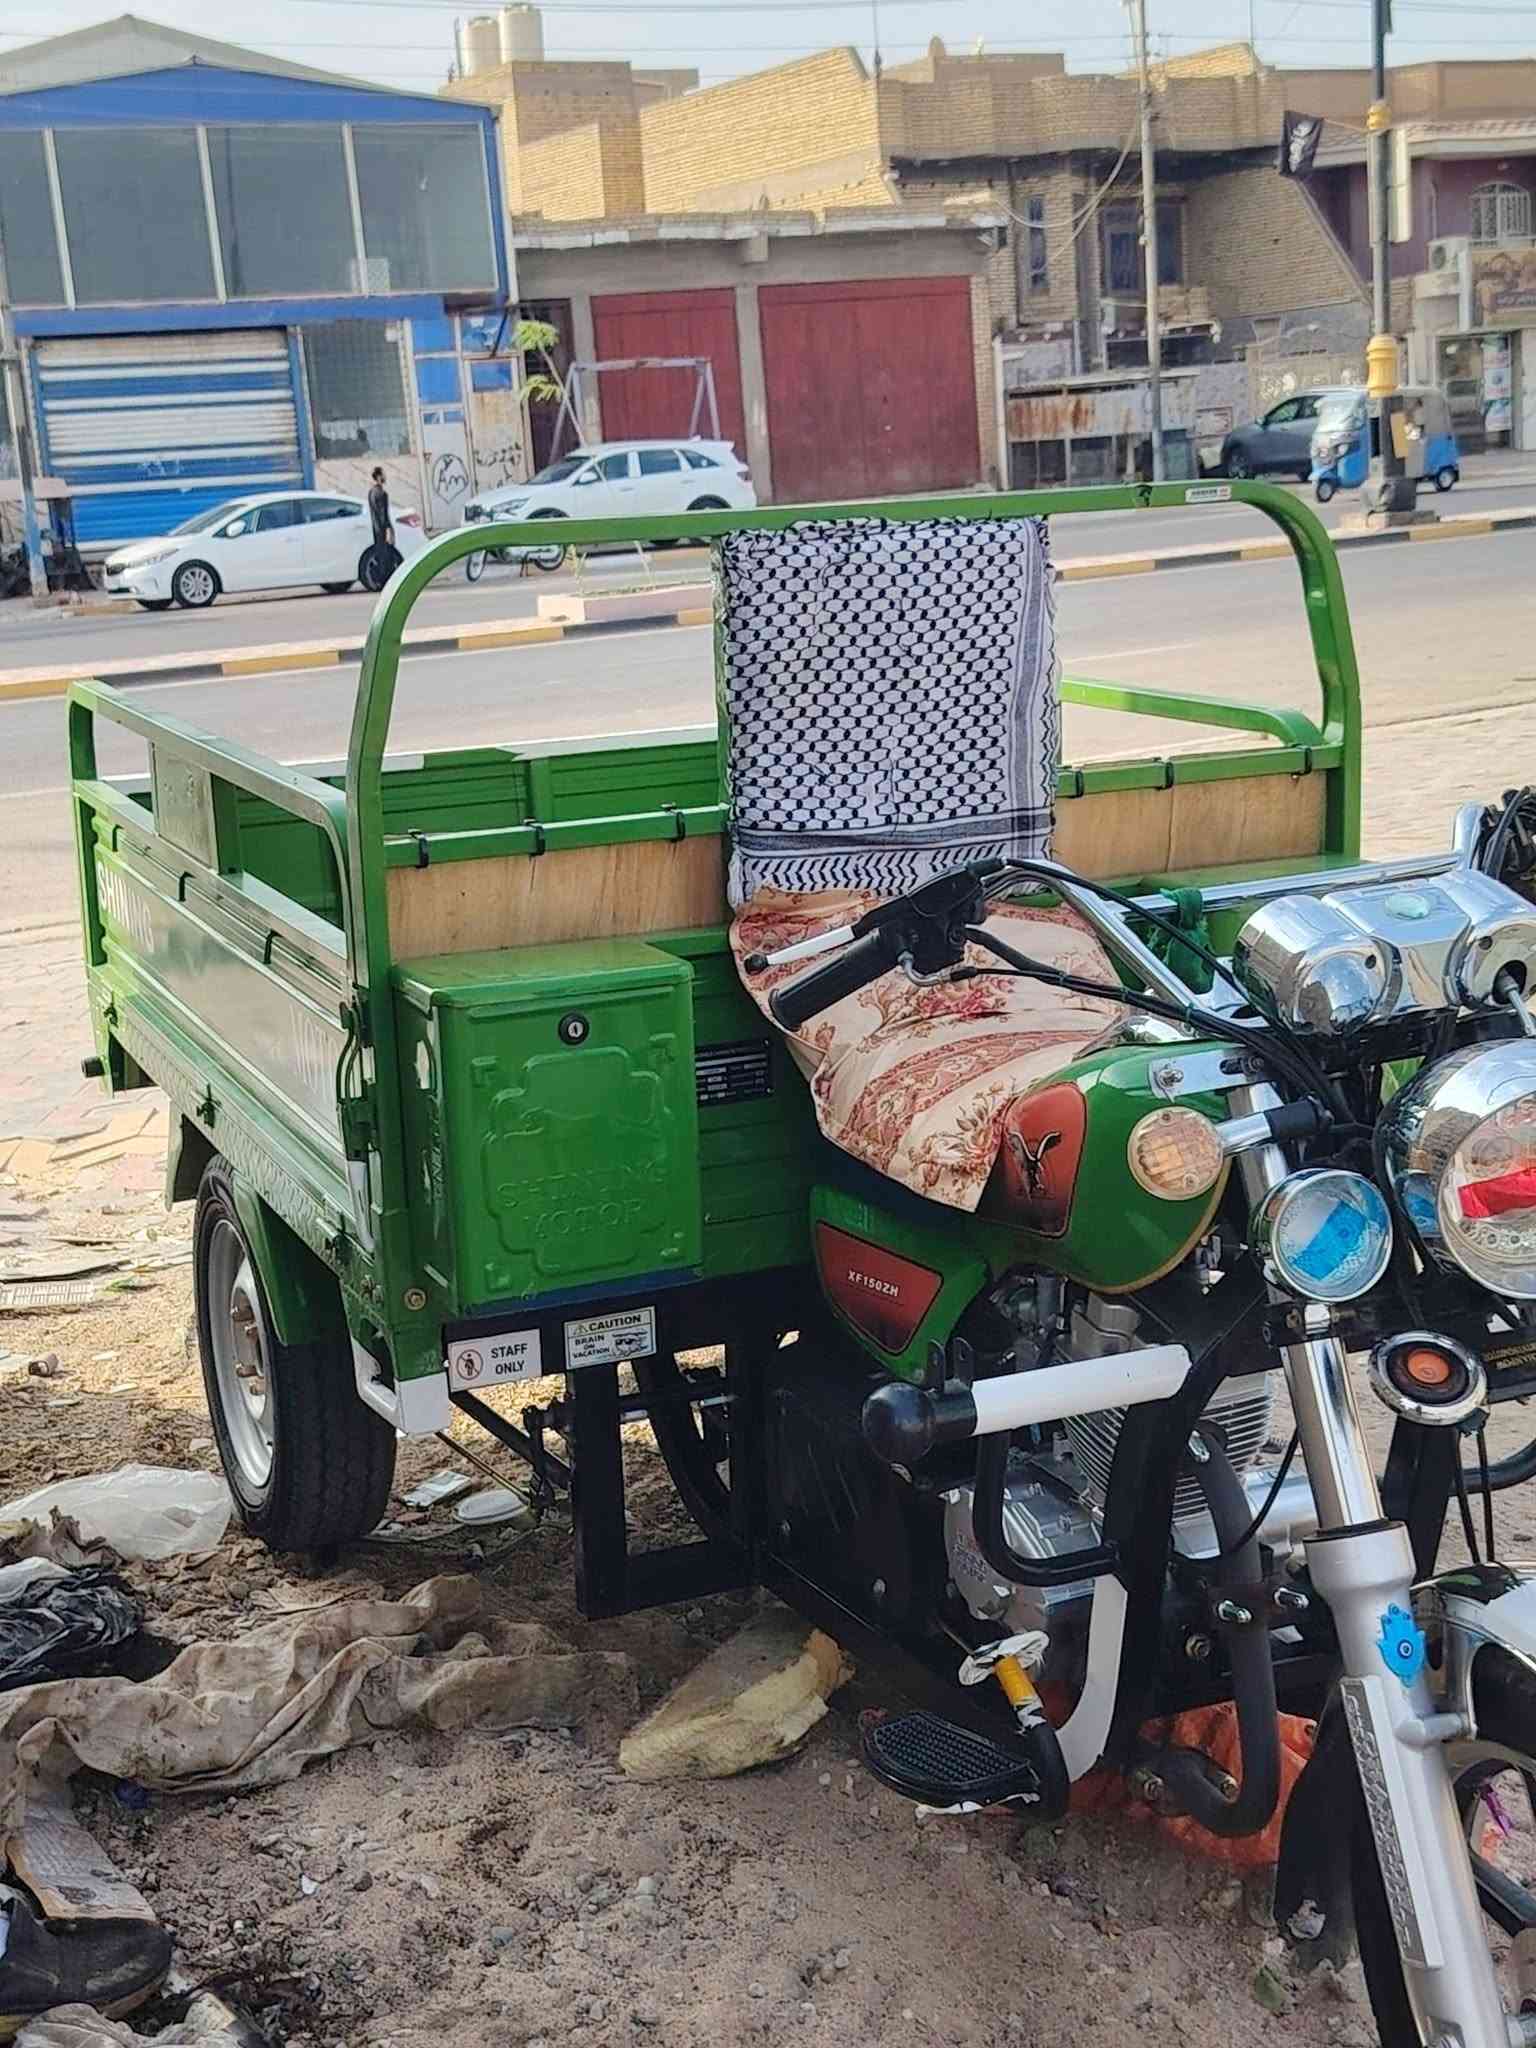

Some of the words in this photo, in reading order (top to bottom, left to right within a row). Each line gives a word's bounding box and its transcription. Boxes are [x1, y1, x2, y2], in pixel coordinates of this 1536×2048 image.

[96, 861, 155, 953] SHINING
[847, 1269, 899, 1297] XF150ZH
[588, 1314, 642, 1332] CAUTION
[575, 1334, 605, 1346] BRAIN
[490, 1343, 528, 1359] STAFF
[572, 1346, 610, 1359] VACATION
[495, 1360, 525, 1375] ONLY
